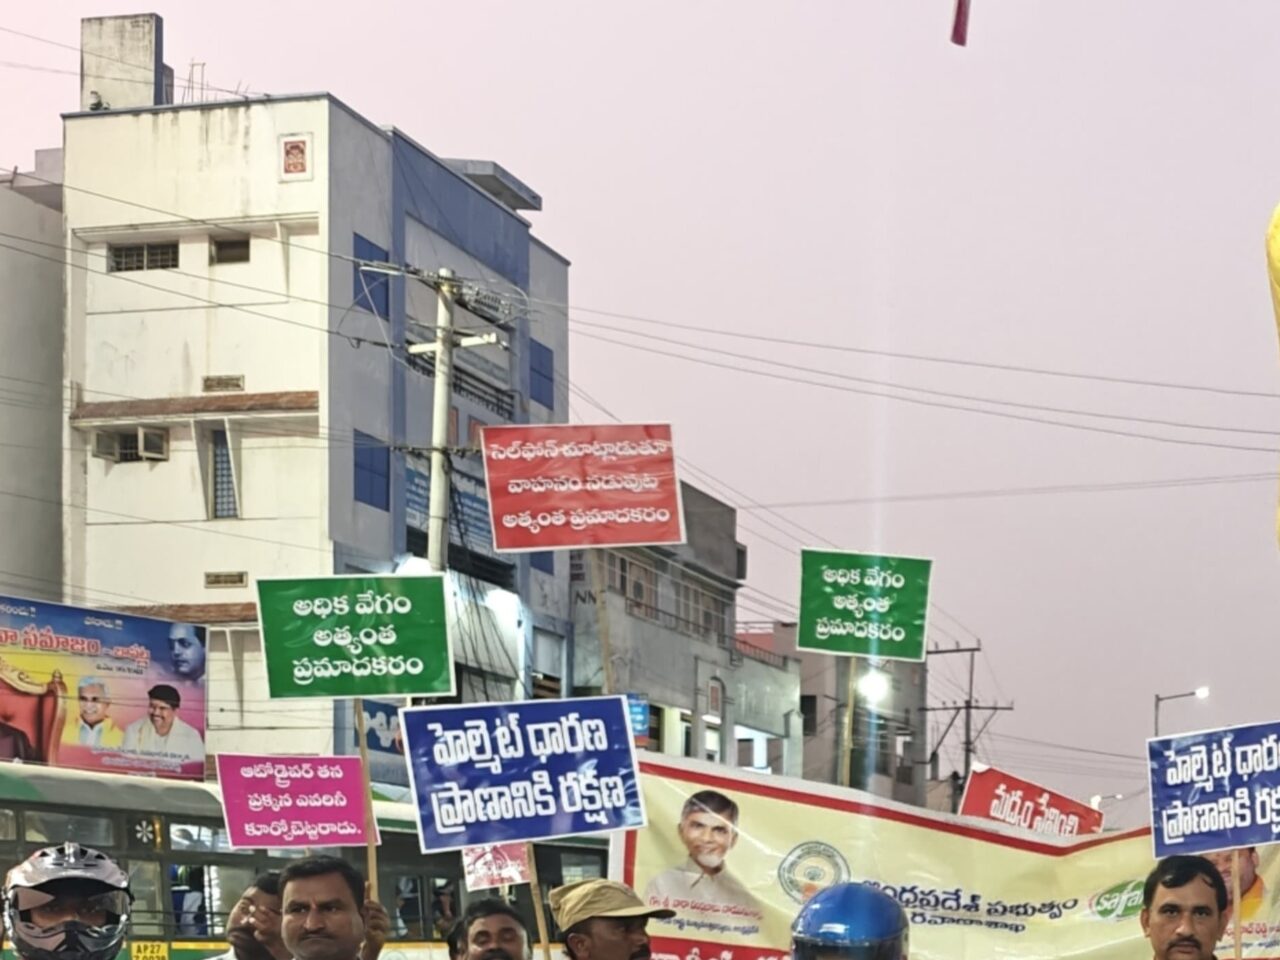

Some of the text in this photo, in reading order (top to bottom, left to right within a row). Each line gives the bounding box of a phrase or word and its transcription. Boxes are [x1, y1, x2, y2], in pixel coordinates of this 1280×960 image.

[507, 476, 580, 494] వాహనం
[502, 507, 671, 534] అత్యంత ప్రమాదకరం
[822, 566, 906, 590] అధిక వేగం
[292, 589, 413, 620] అధిక వేగం
[832, 592, 892, 620] అత్యంత
[312, 624, 398, 655] అత్యంత
[814, 617, 907, 644] ప్రమాదకరం
[292, 654, 425, 685] ప్రమాదకరం
[525, 711, 609, 764] ధారణ
[317, 764, 344, 779] తన
[430, 767, 627, 836] ప్రాణానికి రక్షణ
[1161, 786, 1252, 846] ప్రాణానికి
[986, 897, 1079, 920] ప్రభుత్వం
